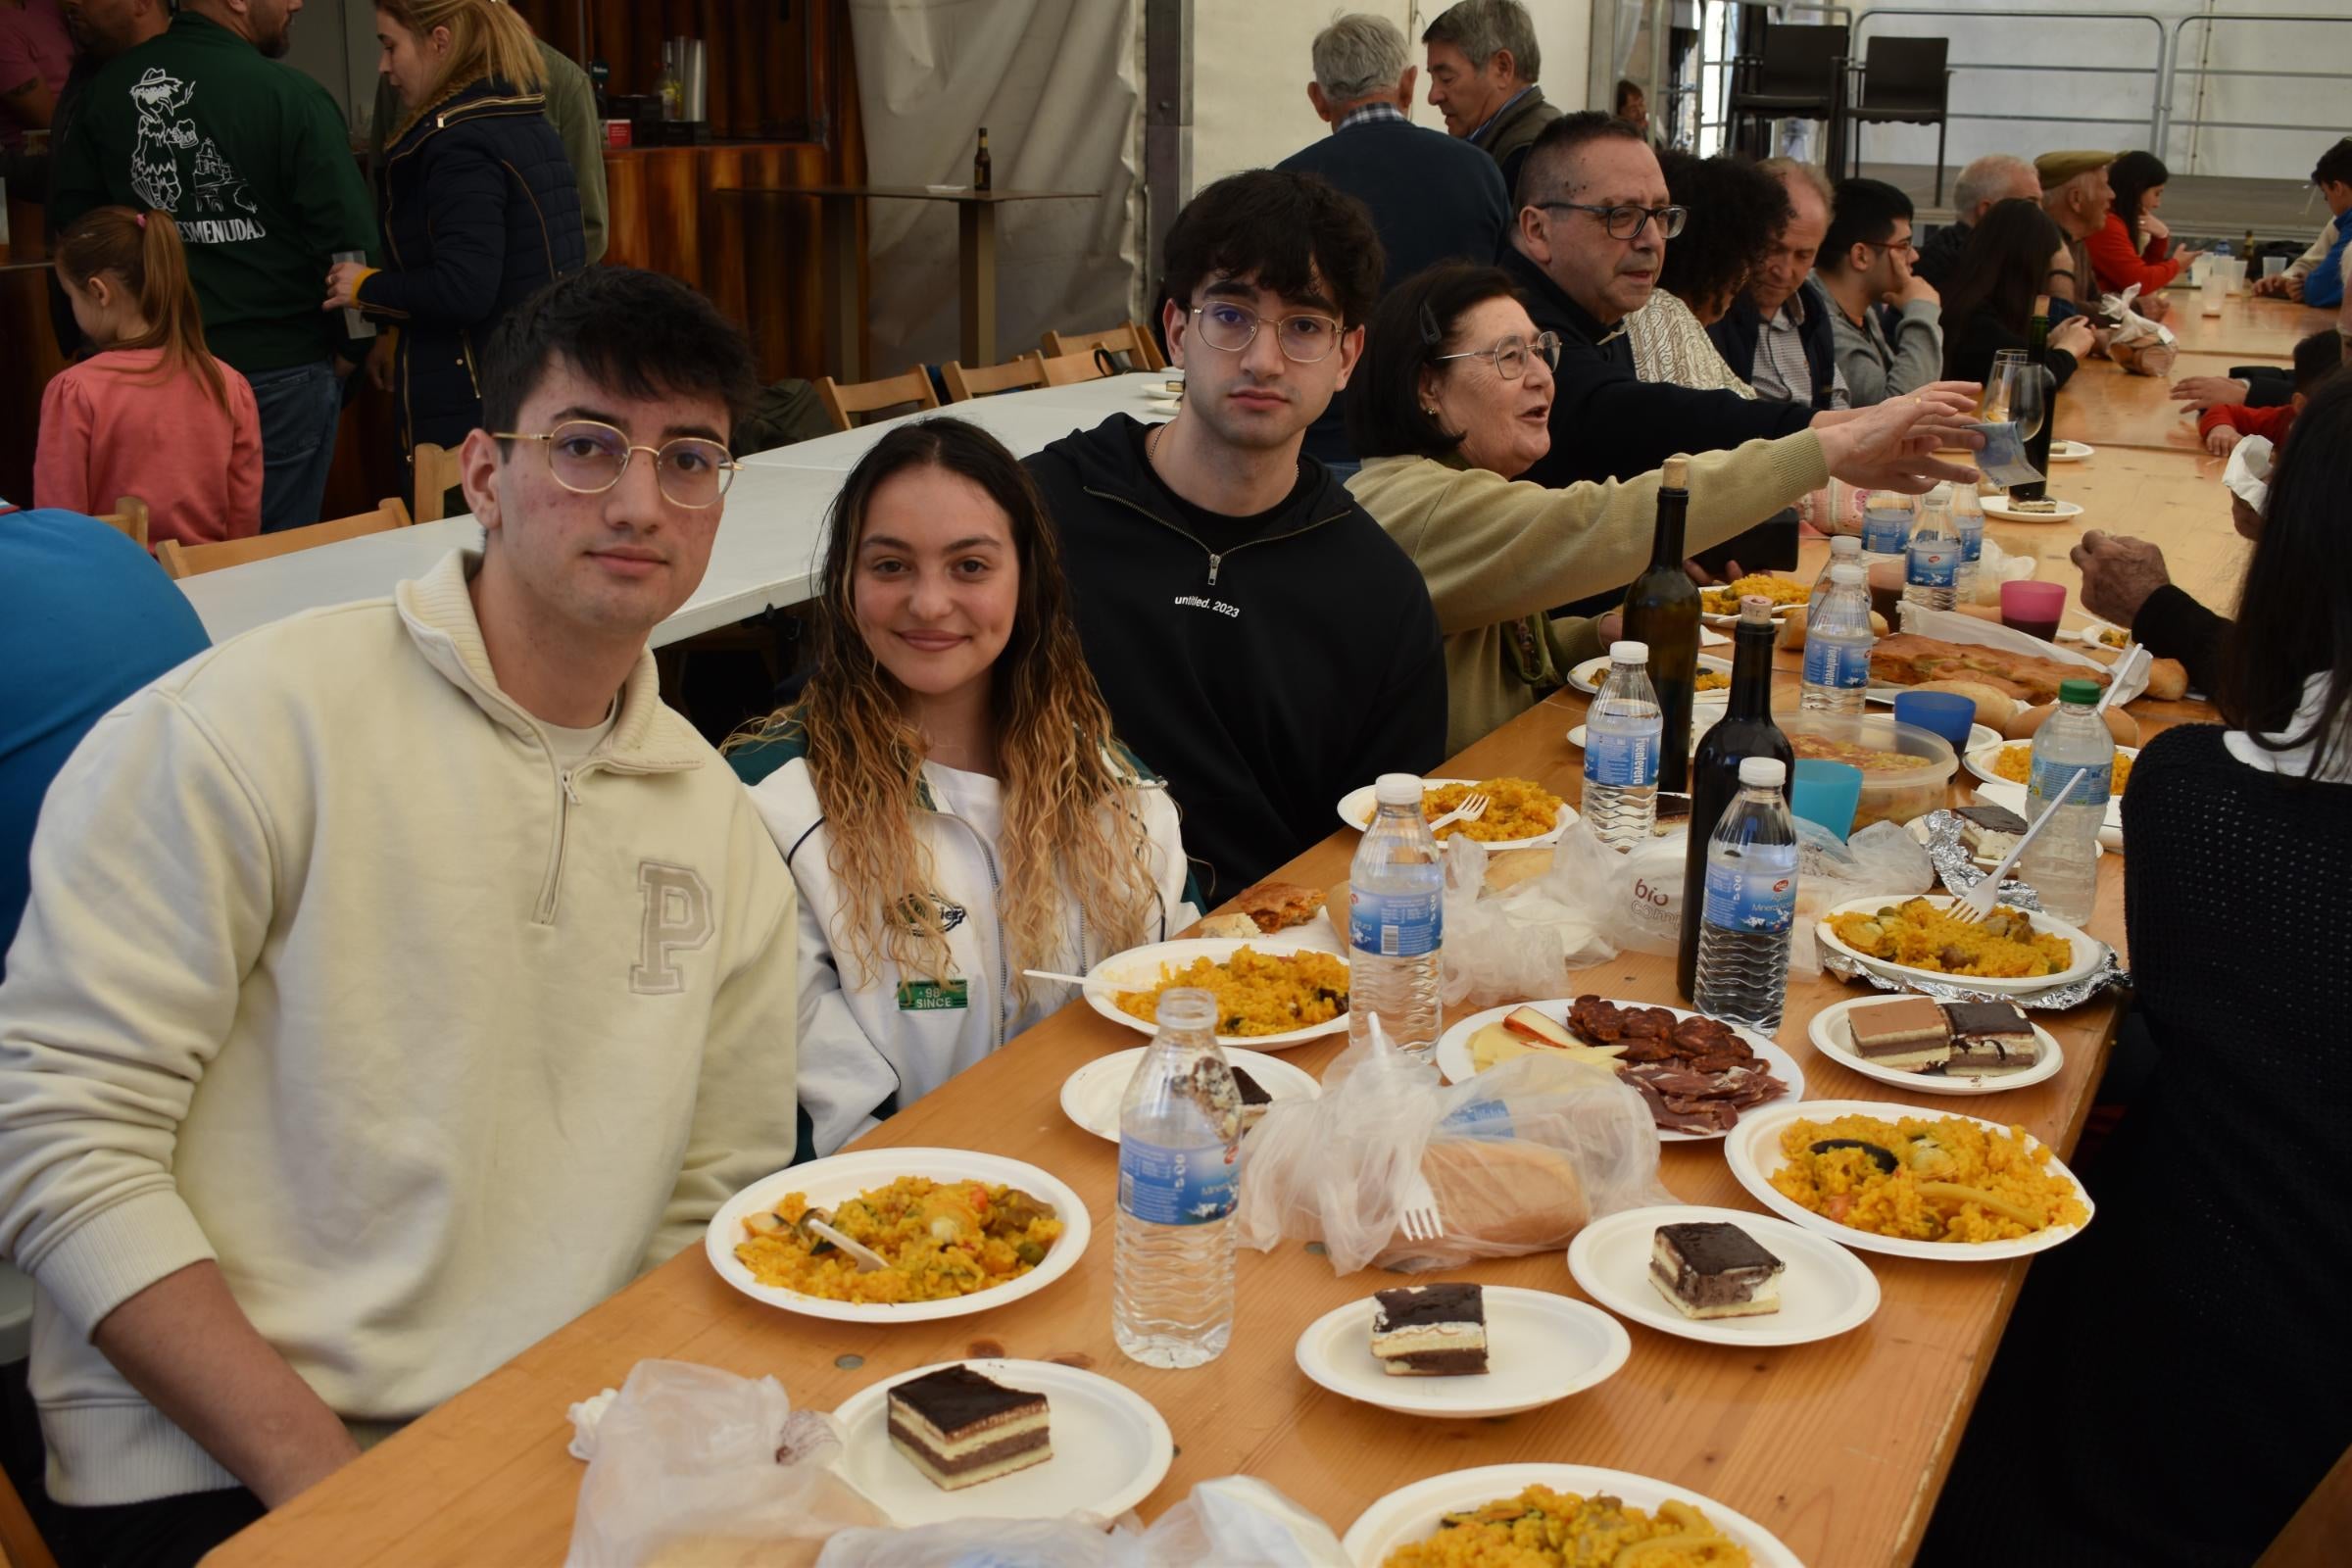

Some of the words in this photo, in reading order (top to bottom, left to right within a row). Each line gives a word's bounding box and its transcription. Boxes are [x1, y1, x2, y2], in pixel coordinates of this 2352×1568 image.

[174, 218, 266, 243] ESMENUDAS
[1174, 595, 1210, 609] untitled.
[1212, 601, 1240, 618] 2023
[1635, 878, 1669, 906] bio
[628, 858, 715, 995] P
[1631, 900, 1683, 931] comp
[916, 997, 953, 1008] SINCE
[925, 987, 941, 999] 98
